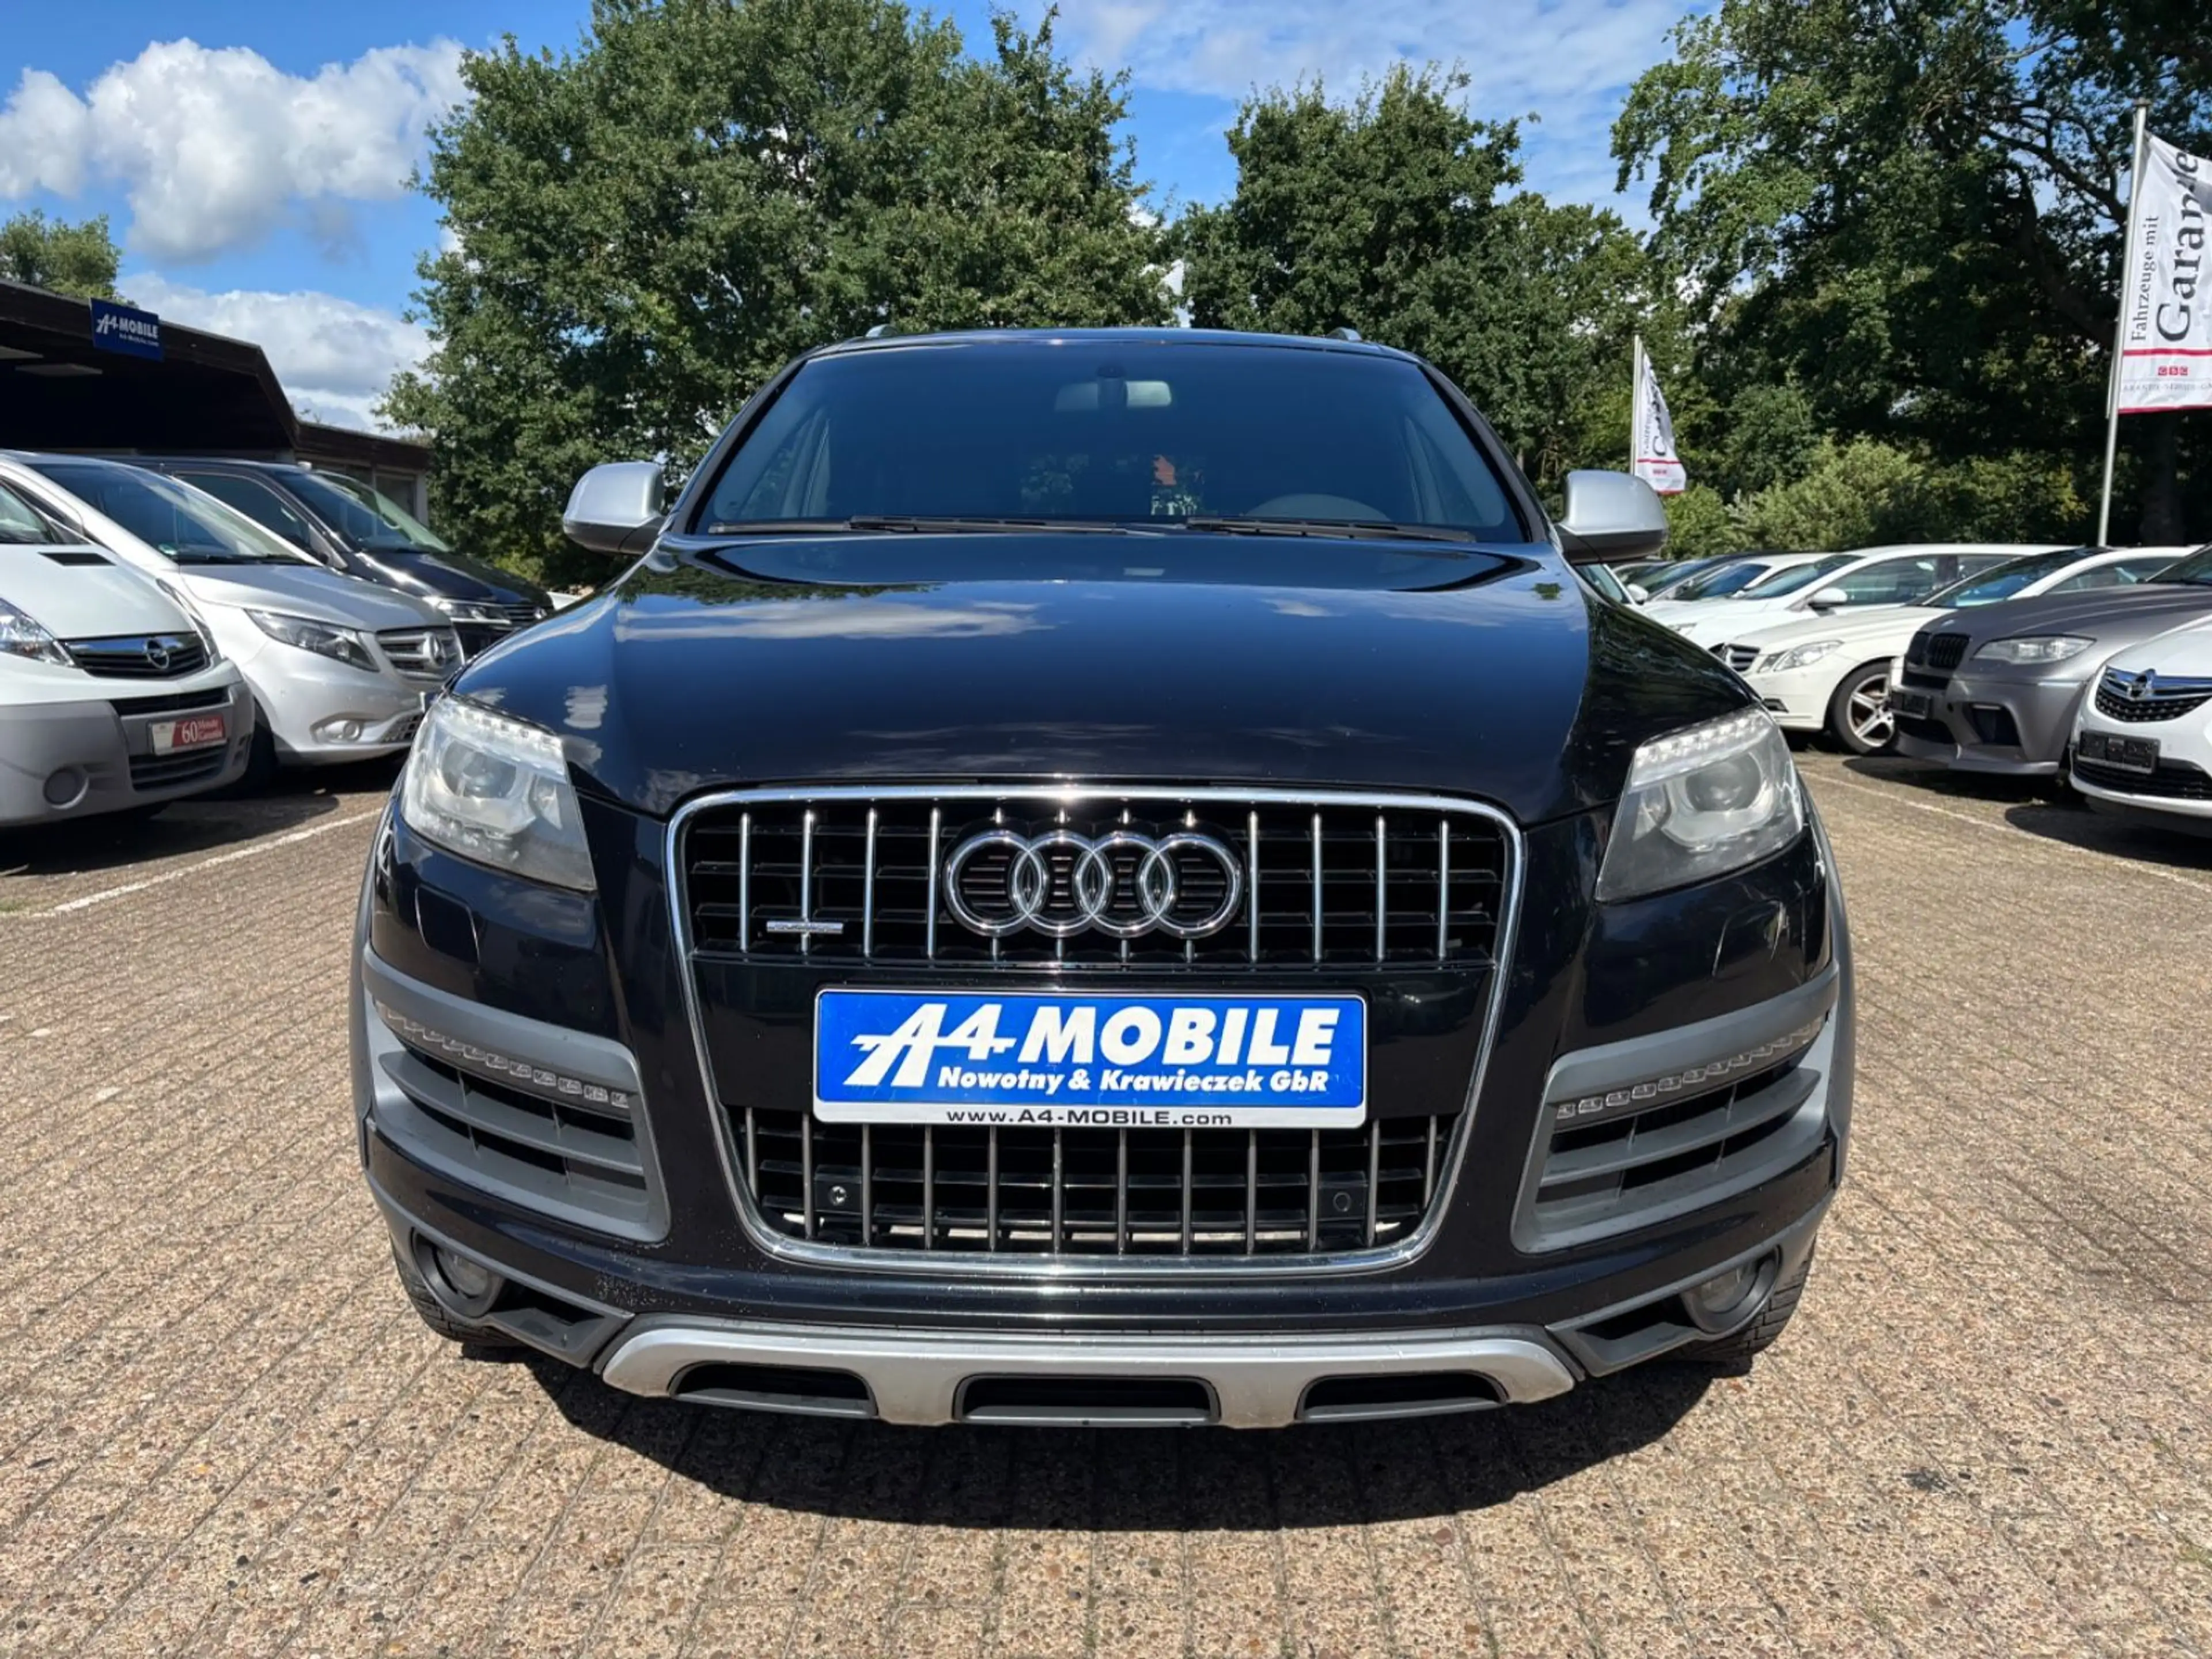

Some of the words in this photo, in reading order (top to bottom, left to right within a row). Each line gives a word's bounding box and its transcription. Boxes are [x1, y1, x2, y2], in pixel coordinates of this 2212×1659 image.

[2142, 216, 2159, 246] mit
[2131, 250, 2157, 341] Fahrzeuge
[181, 721, 198, 744] 60
[938, 1066, 1066, 1095] Nowotny
[1067, 1068, 1091, 1090] &
[1099, 1068, 1264, 1093] Krawieczek
[1269, 1070, 1329, 1093] GbR
[946, 1109, 1233, 1126] www.A4-MOBILE.com
